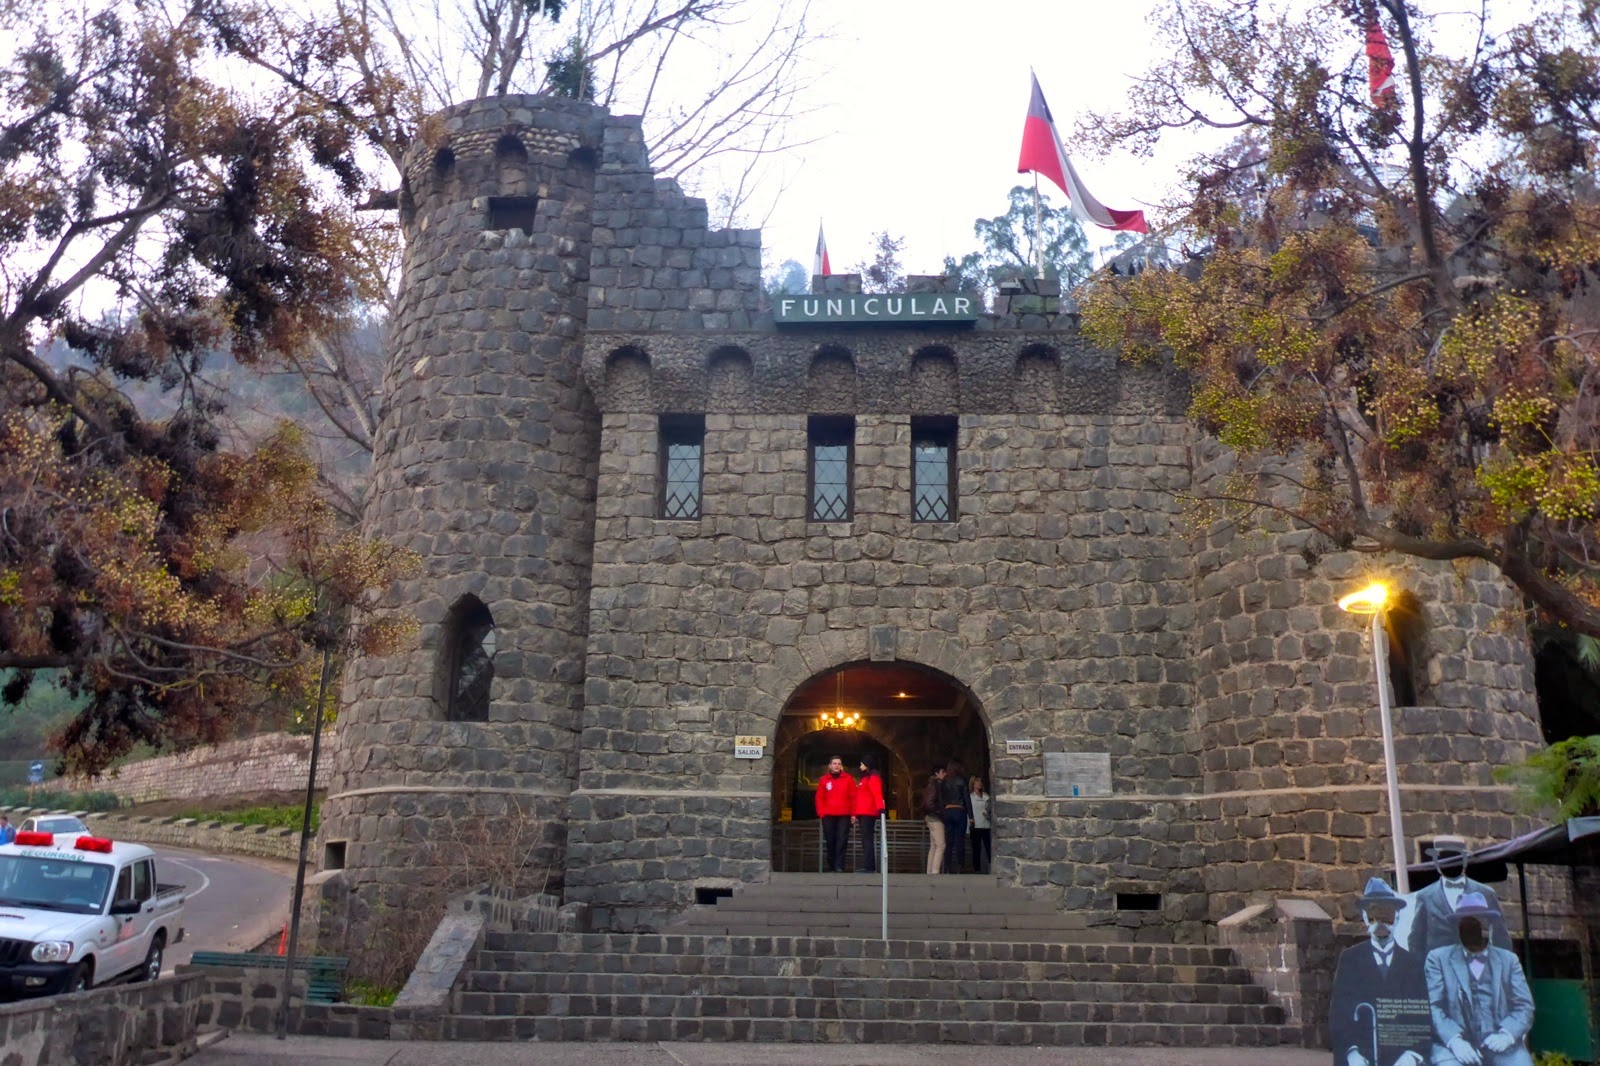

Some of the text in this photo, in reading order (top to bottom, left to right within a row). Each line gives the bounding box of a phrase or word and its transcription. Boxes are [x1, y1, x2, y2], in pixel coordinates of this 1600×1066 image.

[781, 298, 970, 316] FUNICULAR
[740, 737, 761, 746] 445
[20, 850, 85, 861] SEGURIDAD
